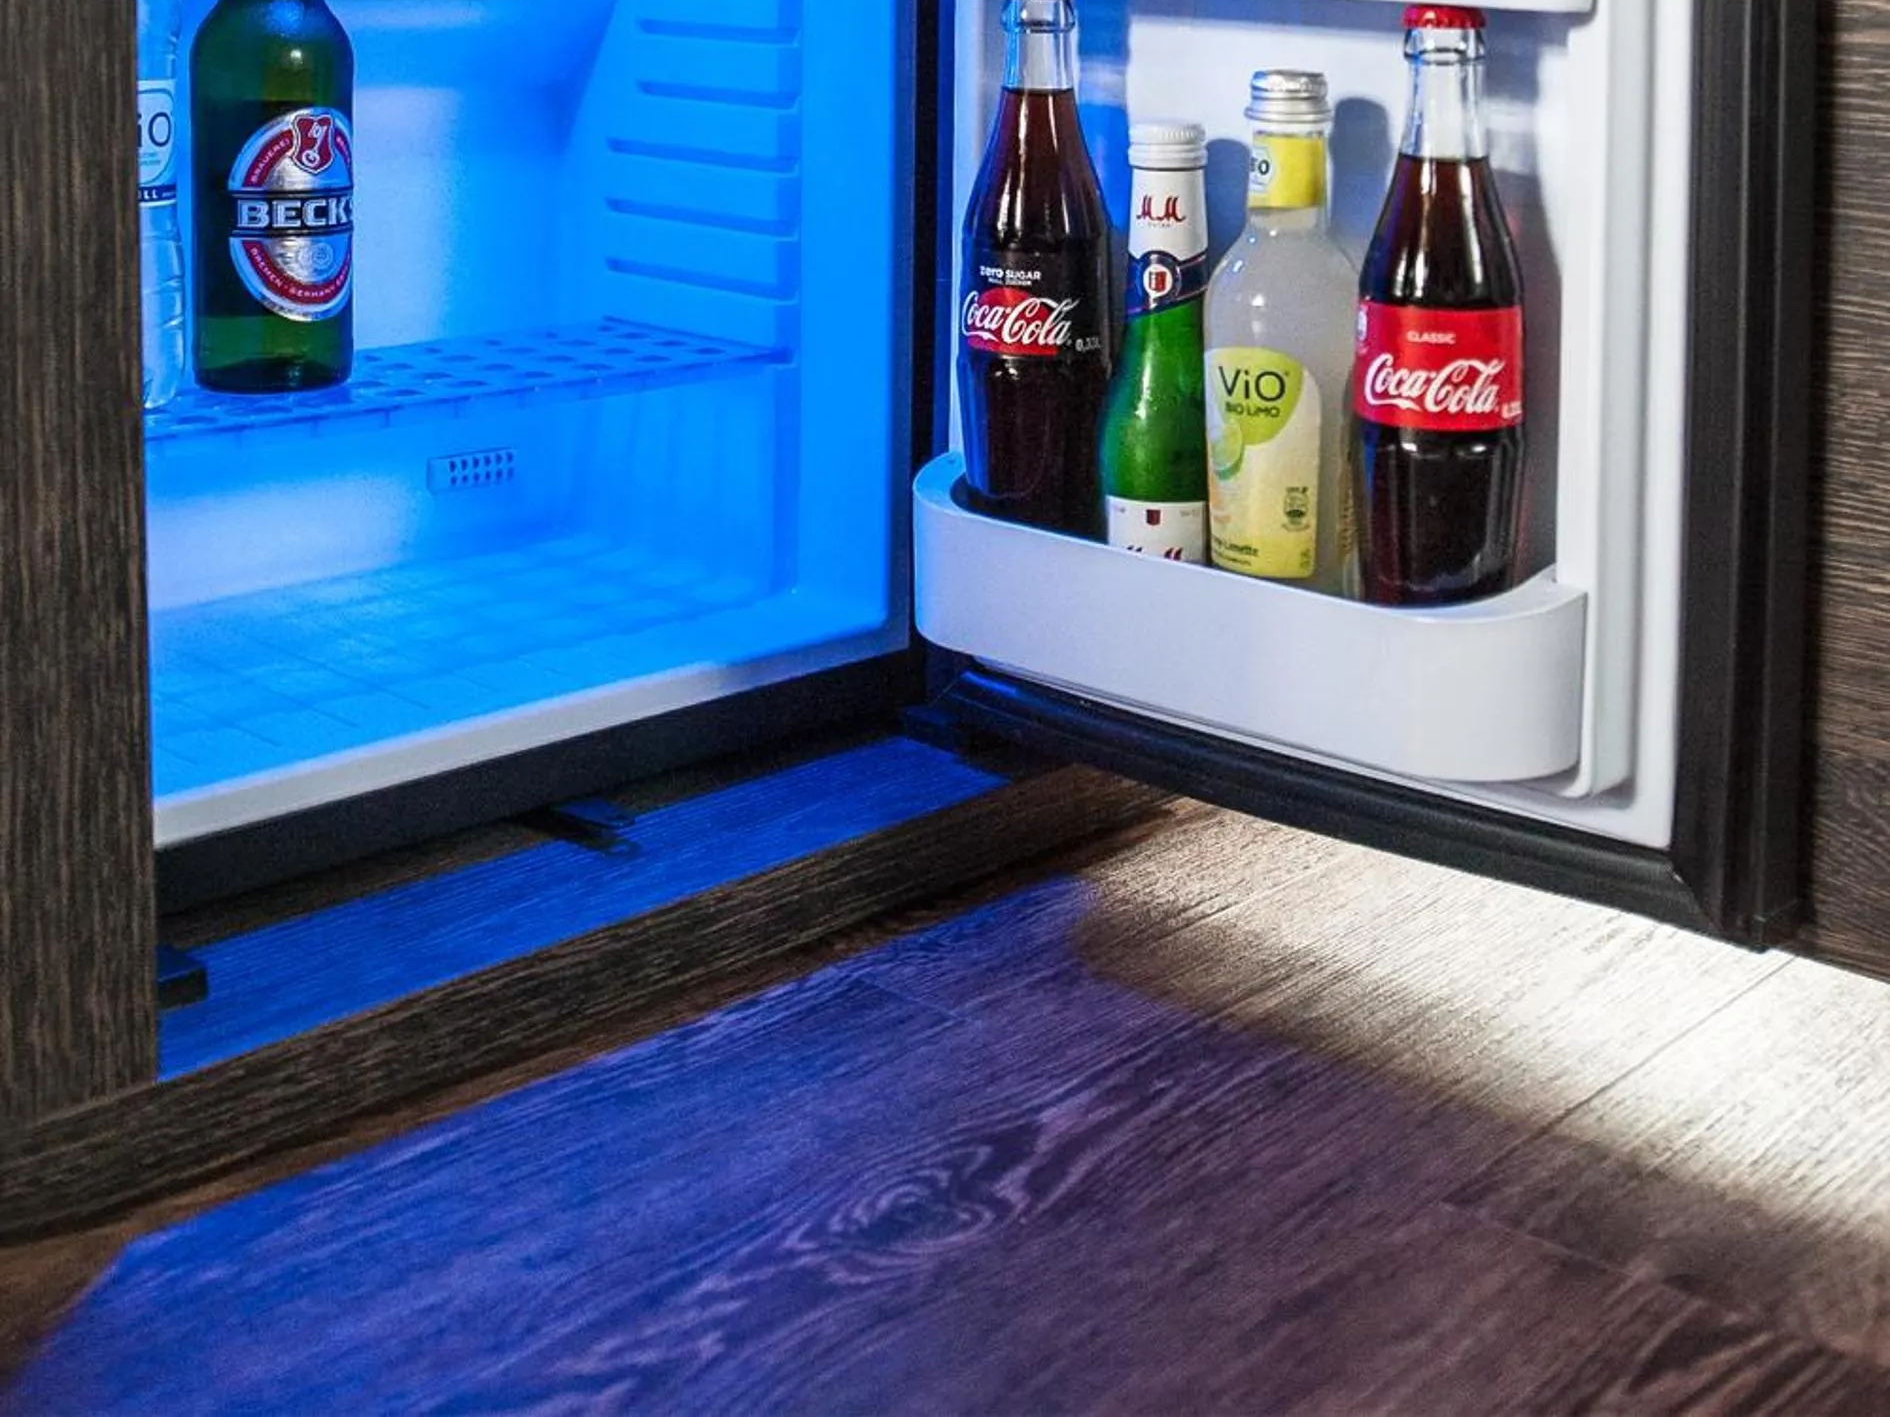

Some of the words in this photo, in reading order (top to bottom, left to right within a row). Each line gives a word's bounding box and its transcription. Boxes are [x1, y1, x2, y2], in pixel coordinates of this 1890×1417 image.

[238, 196, 353, 227] BECK
[1005, 269, 1041, 280] SUGAR
[962, 290, 1080, 346] Coca-Cola
[1406, 330, 1456, 345] CLASSIC
[1218, 366, 1285, 401] ViO
[1364, 353, 1505, 414] Coca-Cola
